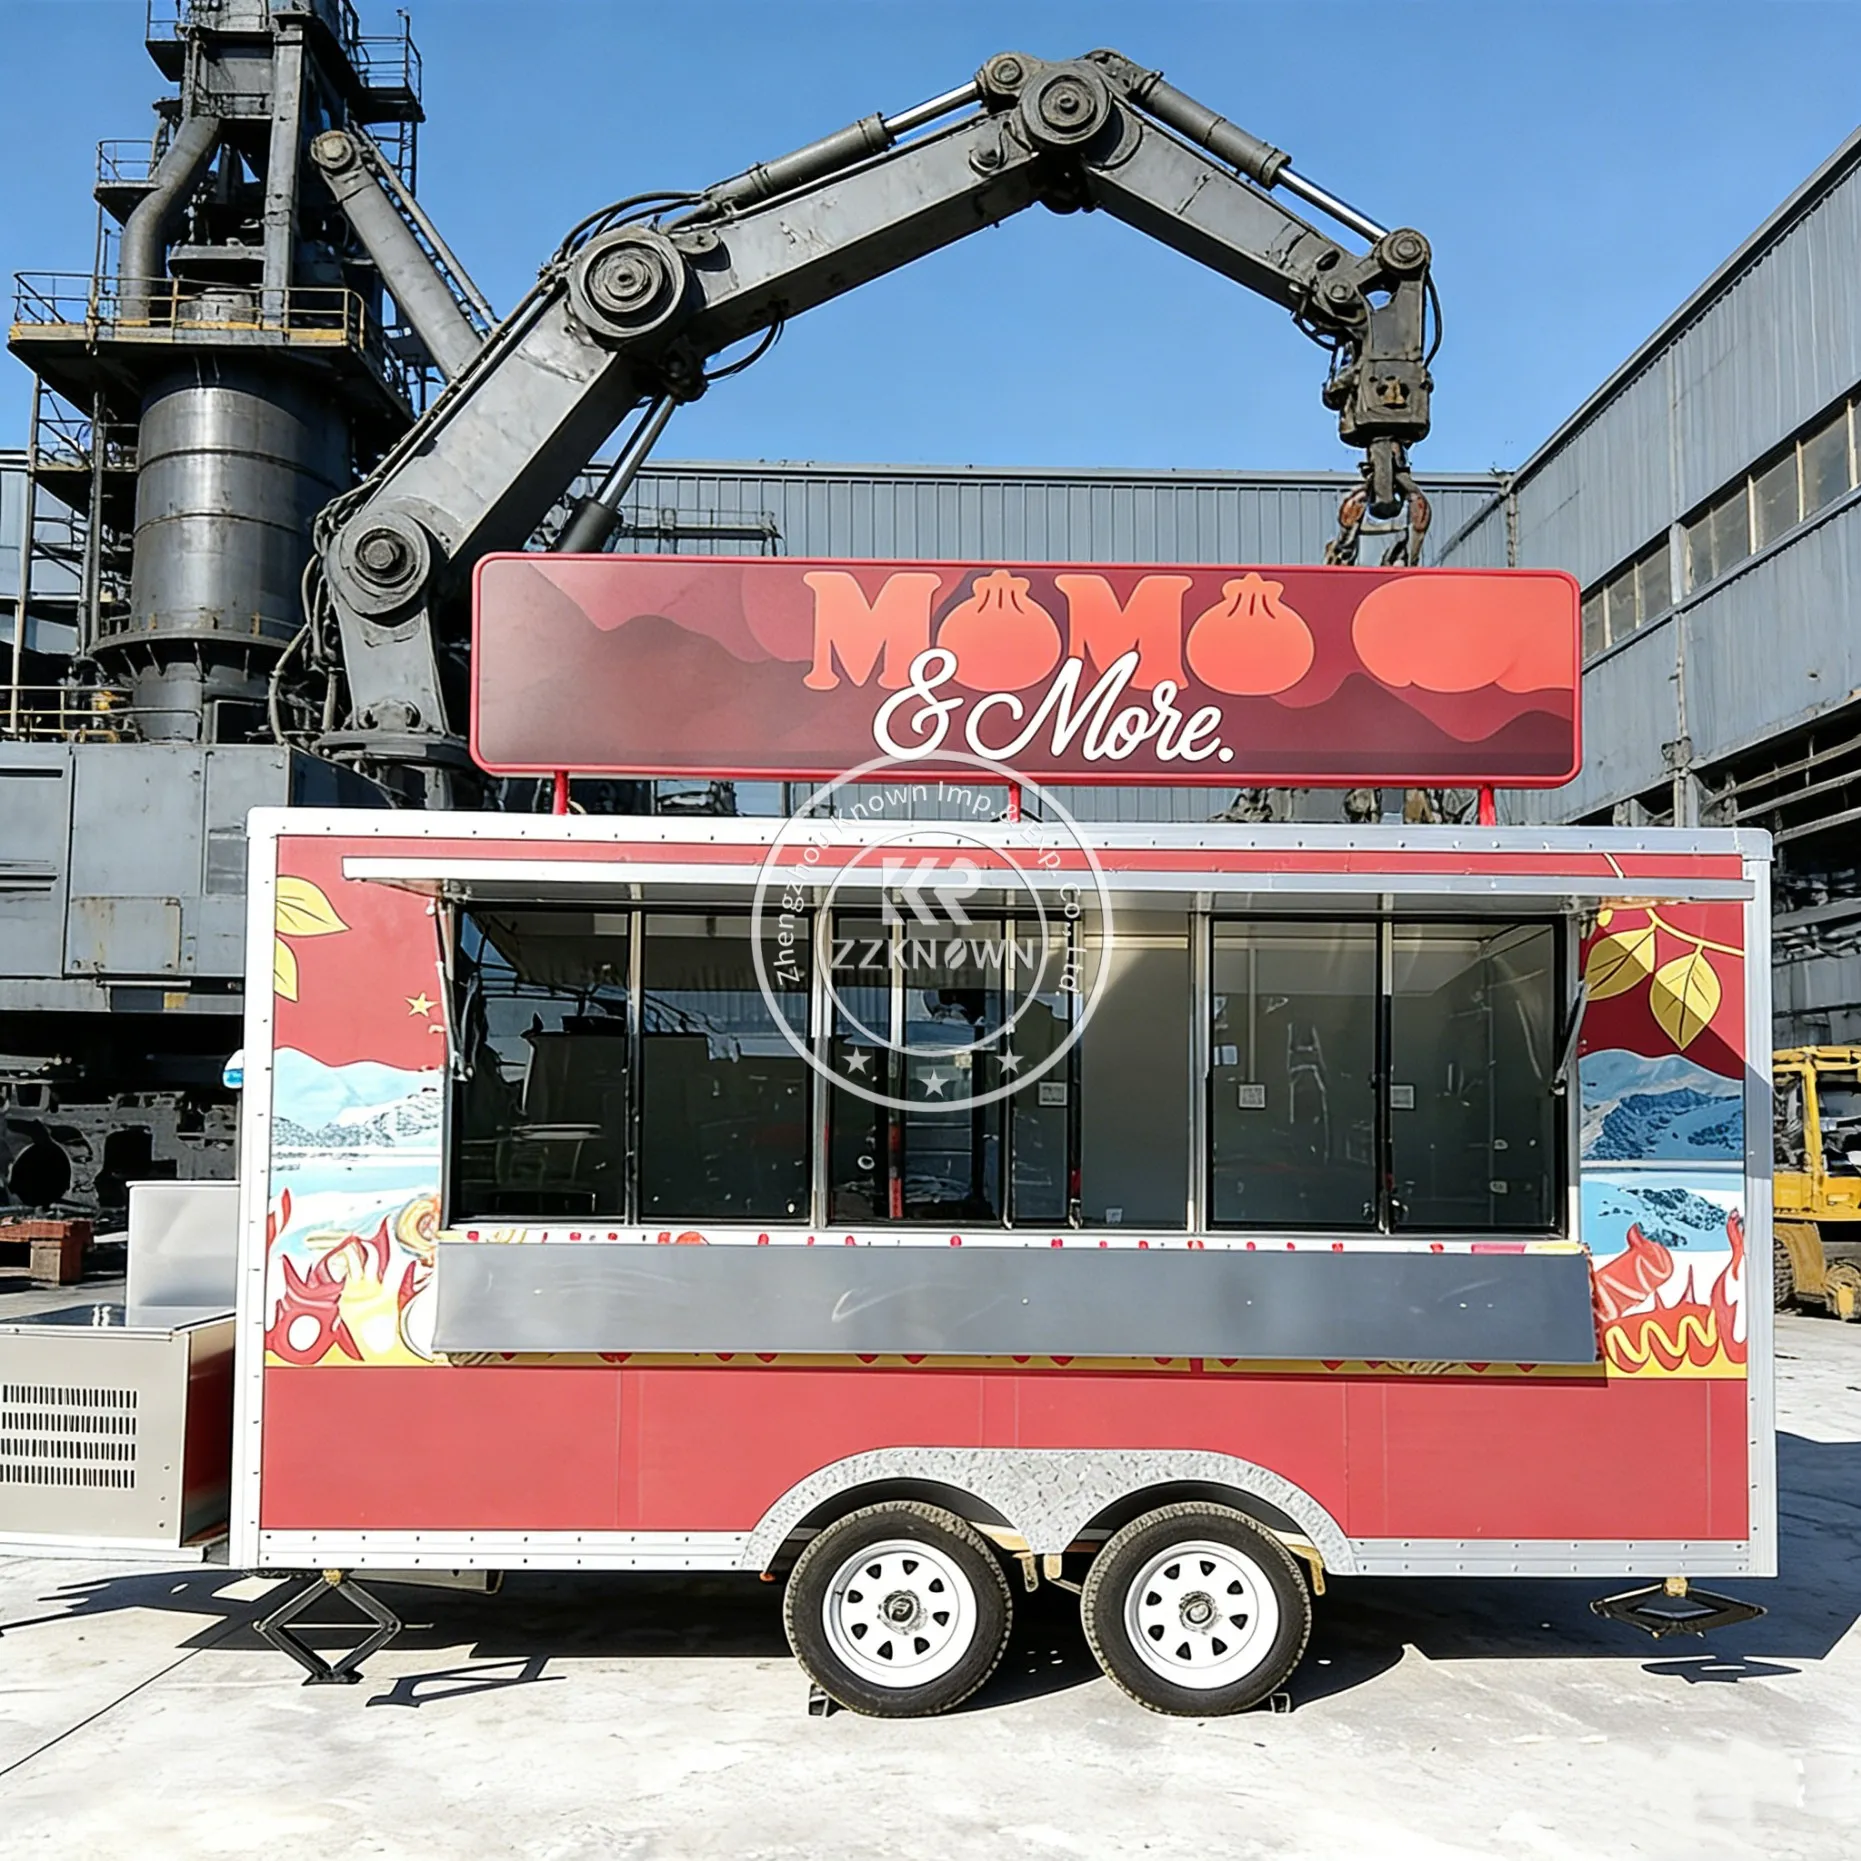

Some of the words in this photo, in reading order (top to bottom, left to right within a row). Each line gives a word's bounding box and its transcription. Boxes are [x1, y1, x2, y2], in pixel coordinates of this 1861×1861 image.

[803, 570, 1314, 695] MOMO
[873, 648, 963, 761] &
[965, 650, 1234, 762] More.
